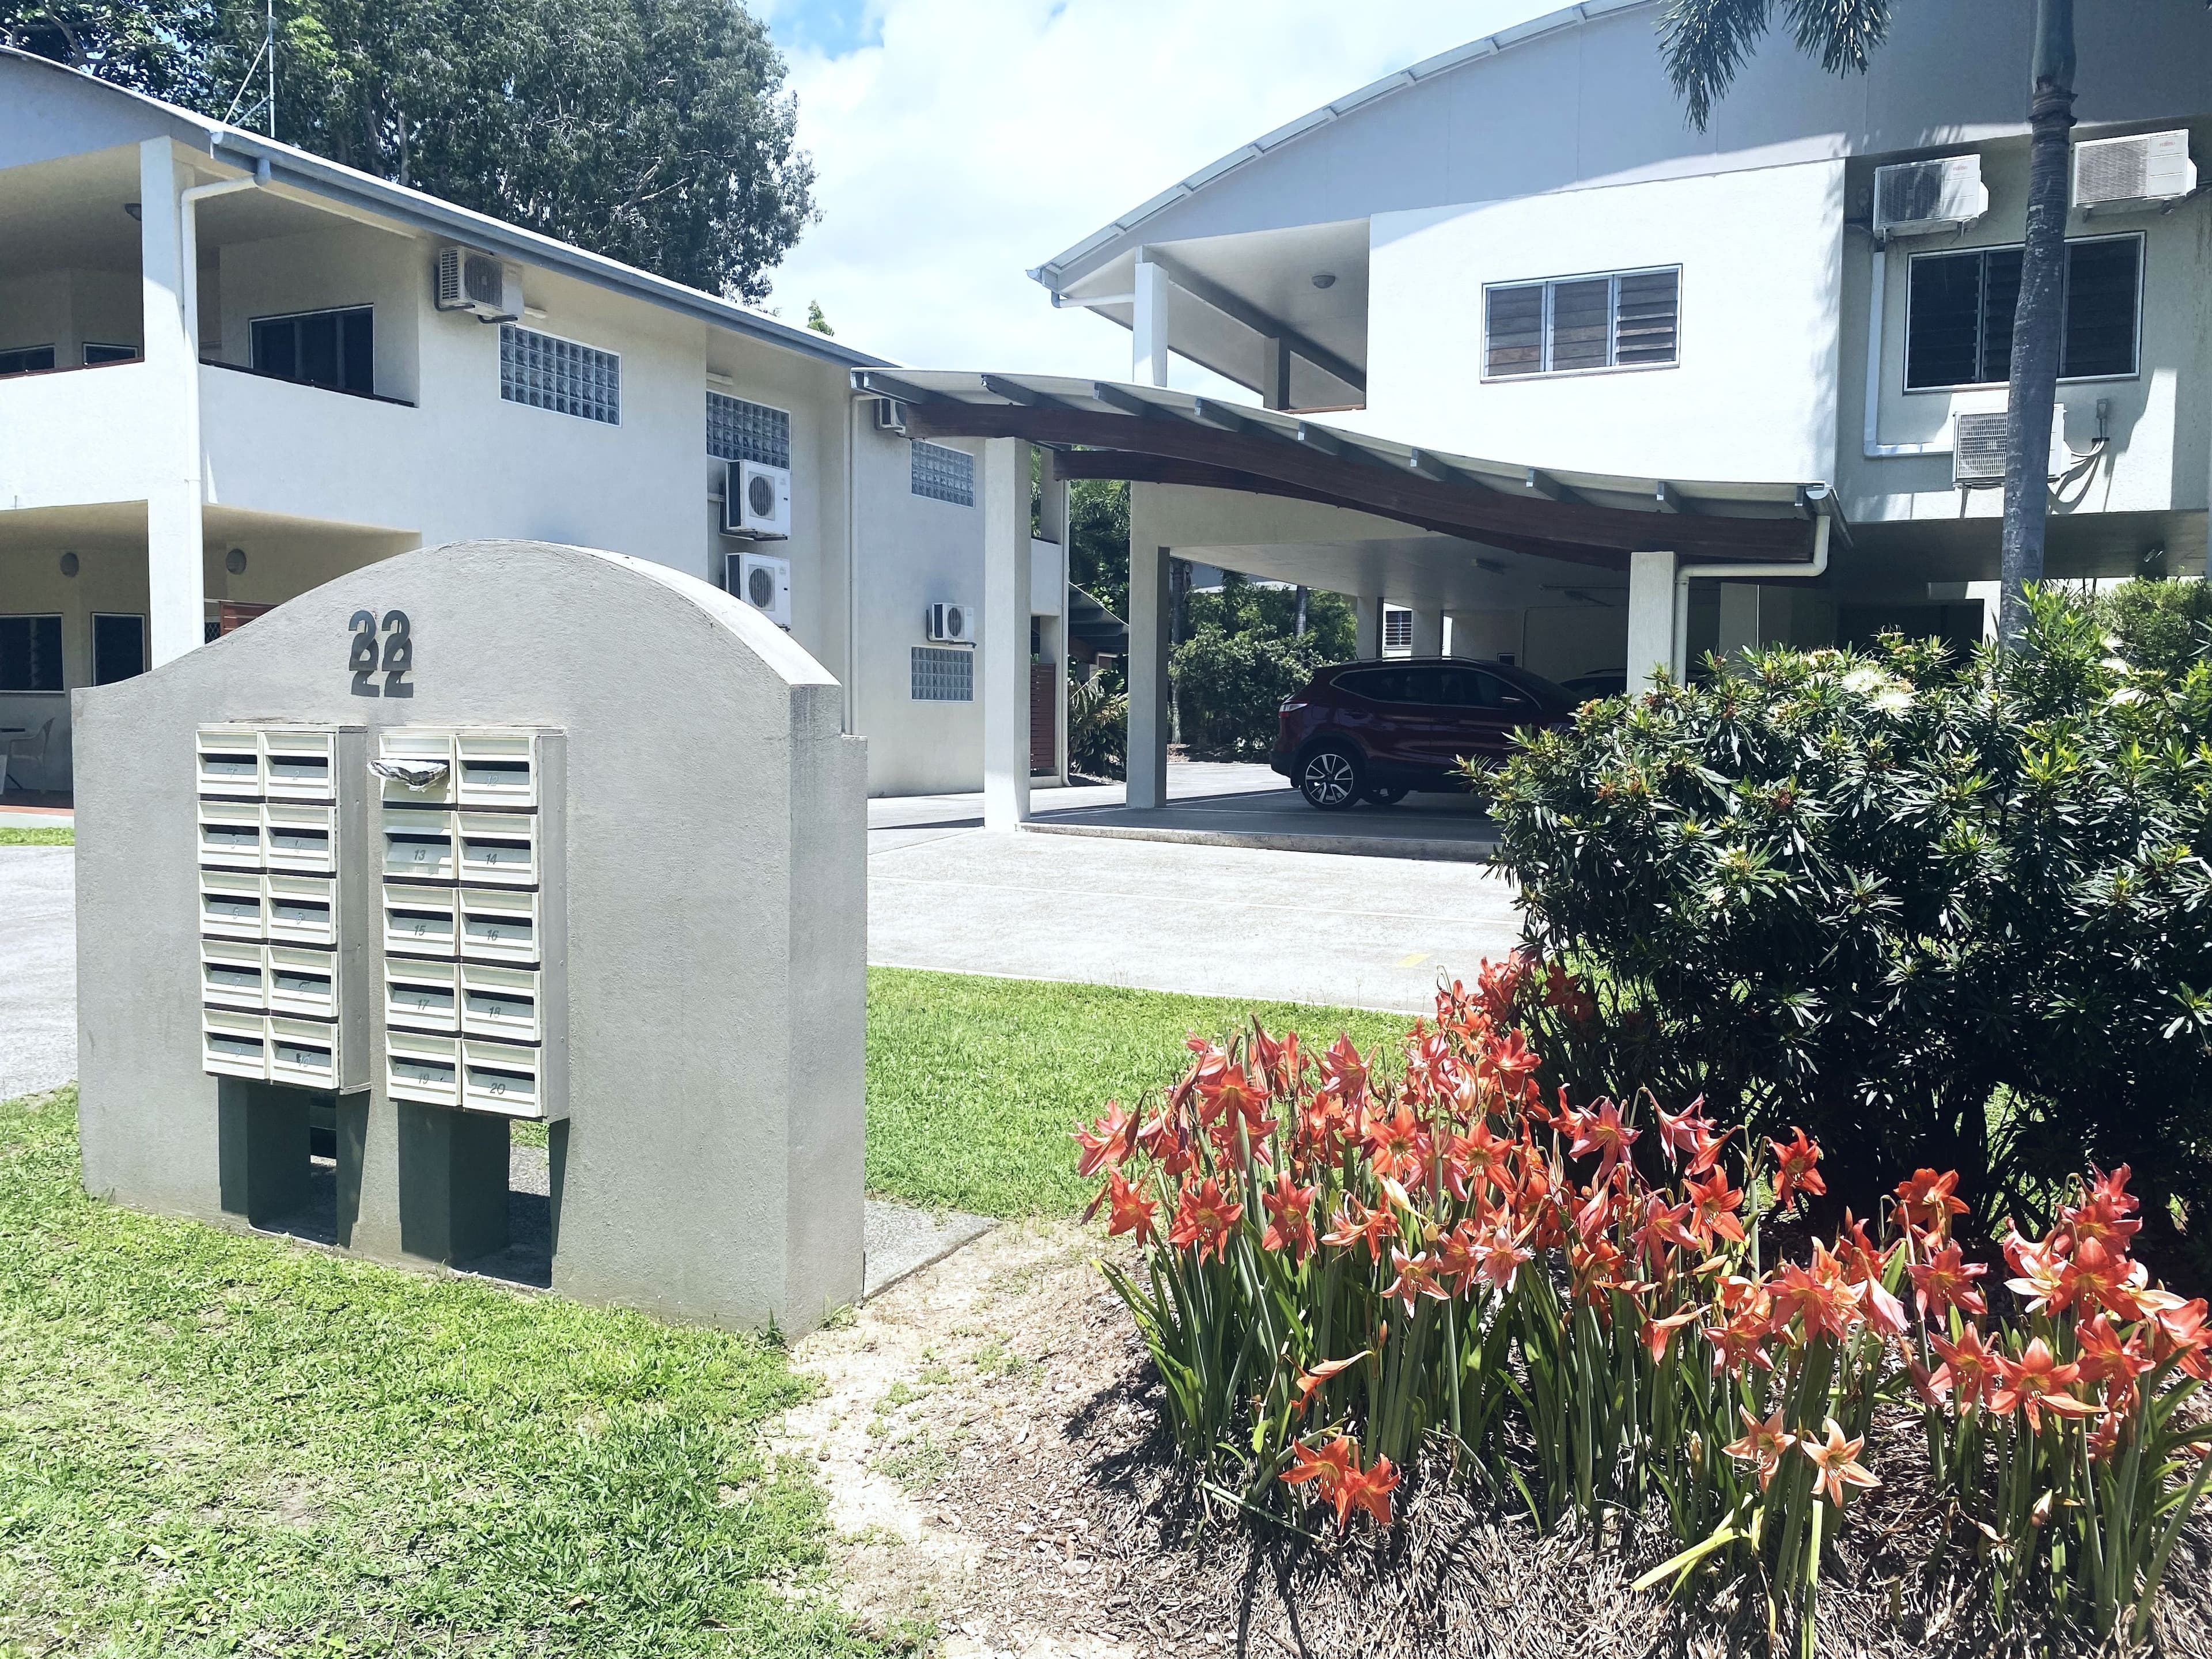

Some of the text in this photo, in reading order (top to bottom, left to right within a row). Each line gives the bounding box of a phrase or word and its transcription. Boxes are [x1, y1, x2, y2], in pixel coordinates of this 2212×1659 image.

[349, 610, 412, 671] 22
[293, 770, 300, 781] 2
[487, 775, 499, 787] 12
[414, 849, 426, 861] 13
[486, 853, 498, 865] 14
[233, 909, 240, 920] 5
[414, 925, 426, 936] 15
[487, 929, 499, 941] 16
[235, 977, 242, 988] 7
[418, 999, 430, 1010] 17
[490, 1006, 502, 1018] 18
[235, 1047, 242, 1058] 9
[299, 1056, 310, 1068] 10
[418, 1073, 430, 1085] 19
[490, 1082, 506, 1095] 20
